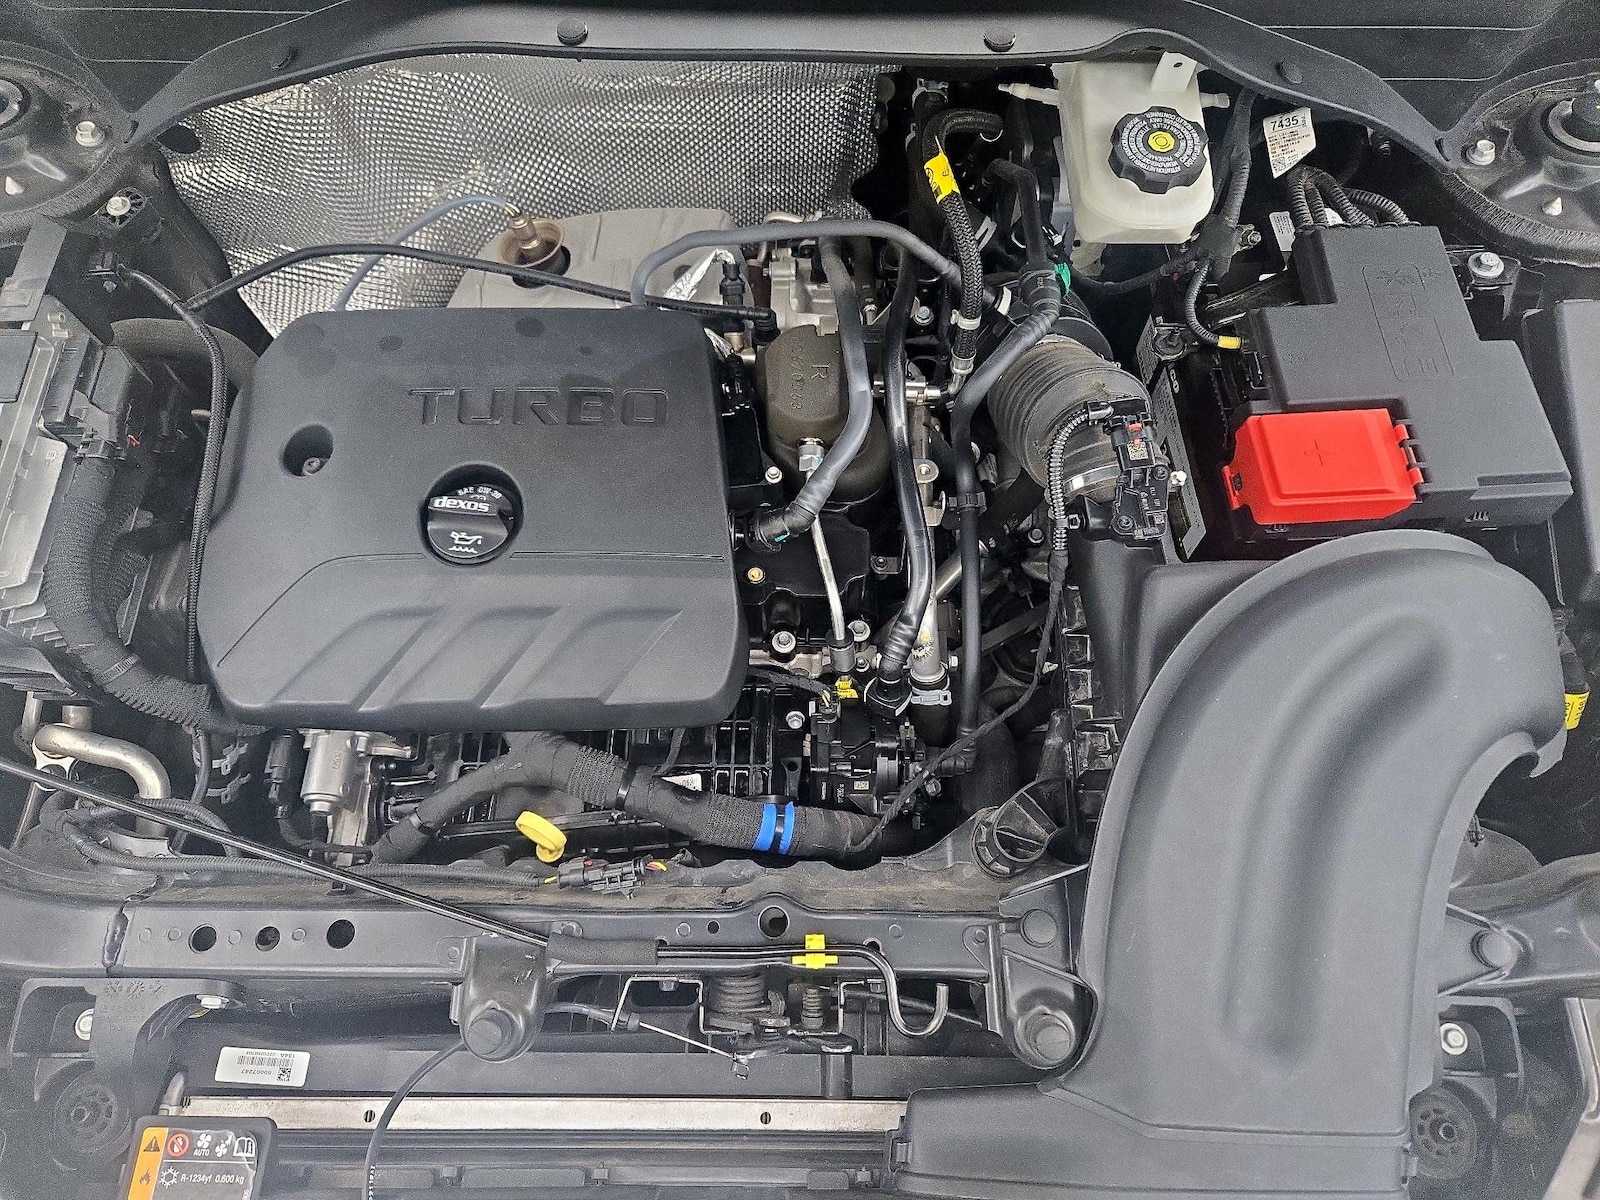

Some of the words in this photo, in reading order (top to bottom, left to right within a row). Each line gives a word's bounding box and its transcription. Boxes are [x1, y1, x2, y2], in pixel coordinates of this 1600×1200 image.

[1270, 115, 1299, 131] 7435
[408, 387, 668, 426] TURBO
[457, 486, 474, 496] SAE
[434, 496, 490, 512] dexos
[192, 1148, 210, 1156] AUTO
[180, 1174, 212, 1184] R-1234yf
[214, 1174, 235, 1184] 0.600
[235, 1174, 245, 1185] kg
